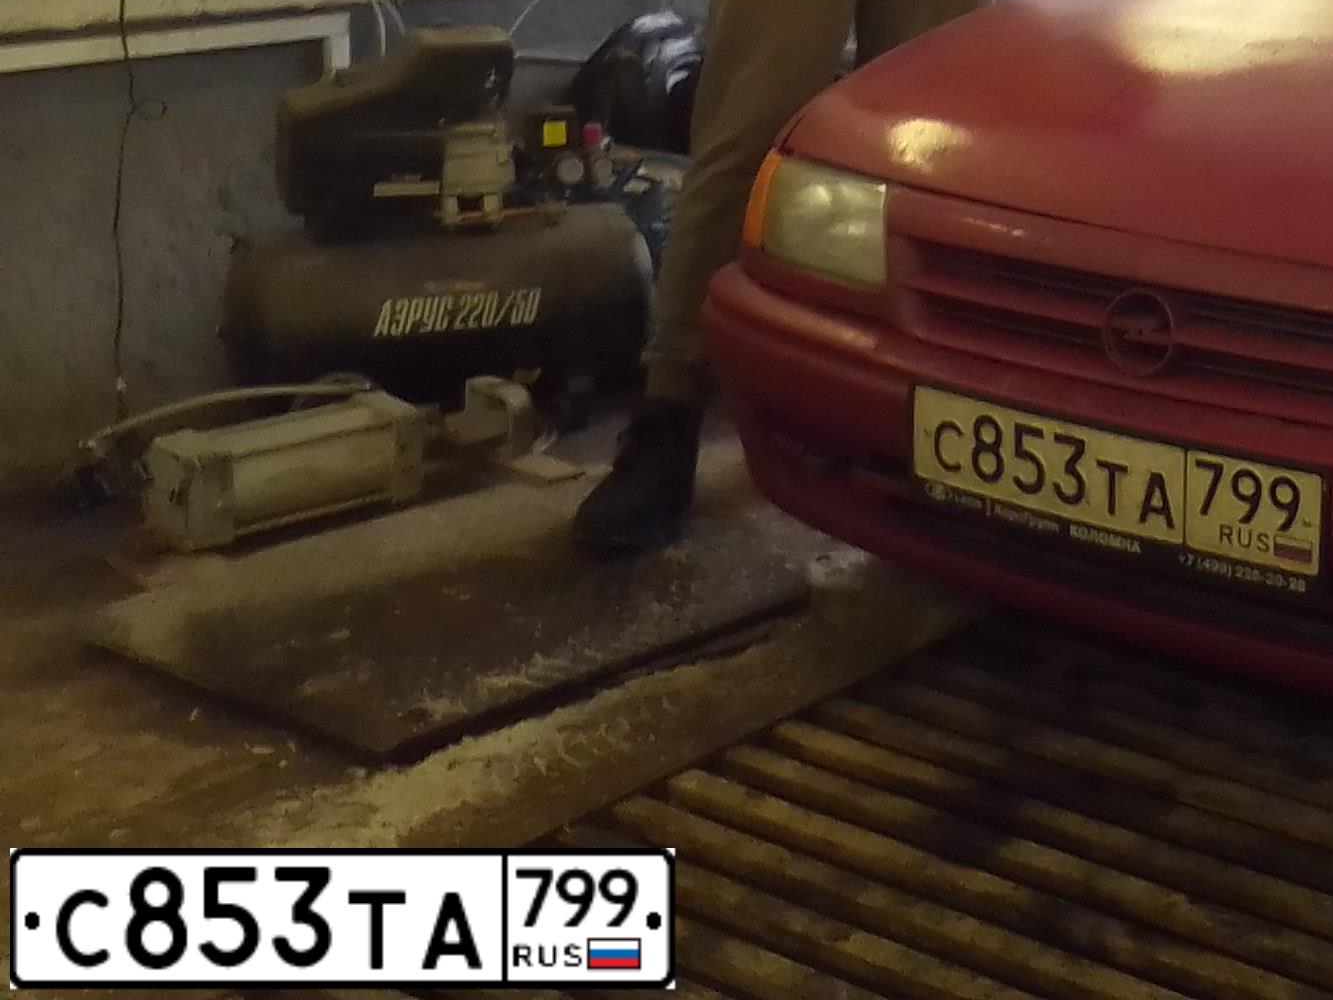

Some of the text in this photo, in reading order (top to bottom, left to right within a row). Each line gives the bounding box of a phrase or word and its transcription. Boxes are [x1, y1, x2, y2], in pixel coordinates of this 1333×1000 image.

[374, 295, 454, 338] АЭРУС
[934, 414, 1301, 532] С853ТА 799
[1219, 524, 1271, 554] RUS
